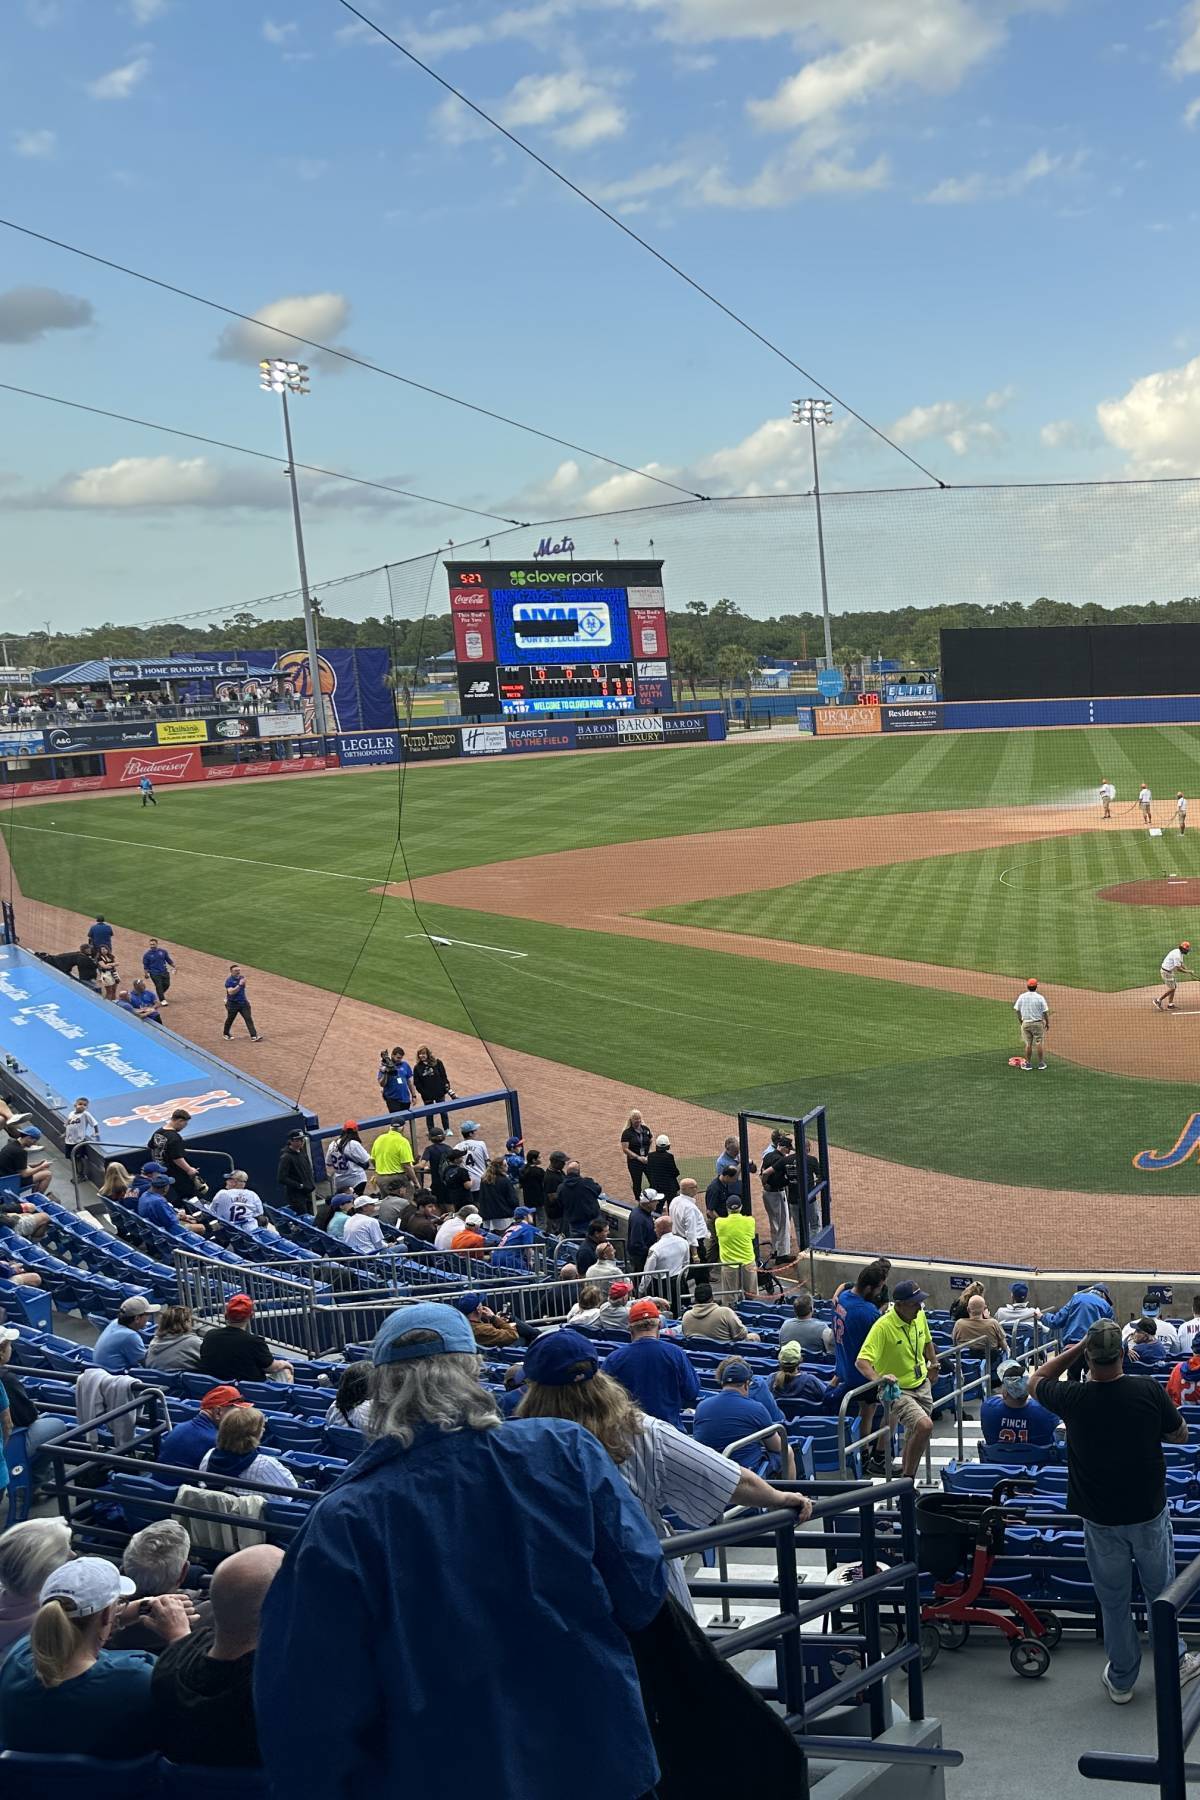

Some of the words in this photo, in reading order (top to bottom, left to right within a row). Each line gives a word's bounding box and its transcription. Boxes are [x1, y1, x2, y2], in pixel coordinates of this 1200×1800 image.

[533, 536, 574, 557] Mets
[145, 666, 167, 674] HOME
[189, 664, 216, 672] HOUSE
[888, 684, 934, 696] ELITE
[888, 710, 927, 718] Residence
[578, 724, 615, 733] BARON
[618, 718, 662, 732] BARON
[665, 719, 700, 729] BARON
[508, 729, 548, 738] NEAREST
[623, 732, 660, 742] LUXURY
[341, 737, 394, 751] LEGLER
[509, 739, 521, 747] TO
[523, 737, 541, 746] THE
[543, 736, 569, 745] FIELD
[344, 749, 393, 758] ORTHODONTICS
[127, 761, 188, 775] Budweiser
[465, 1153, 475, 1166] 4
[229, 1205, 247, 1222] 12
[1001, 1417, 1027, 1429] FINCH
